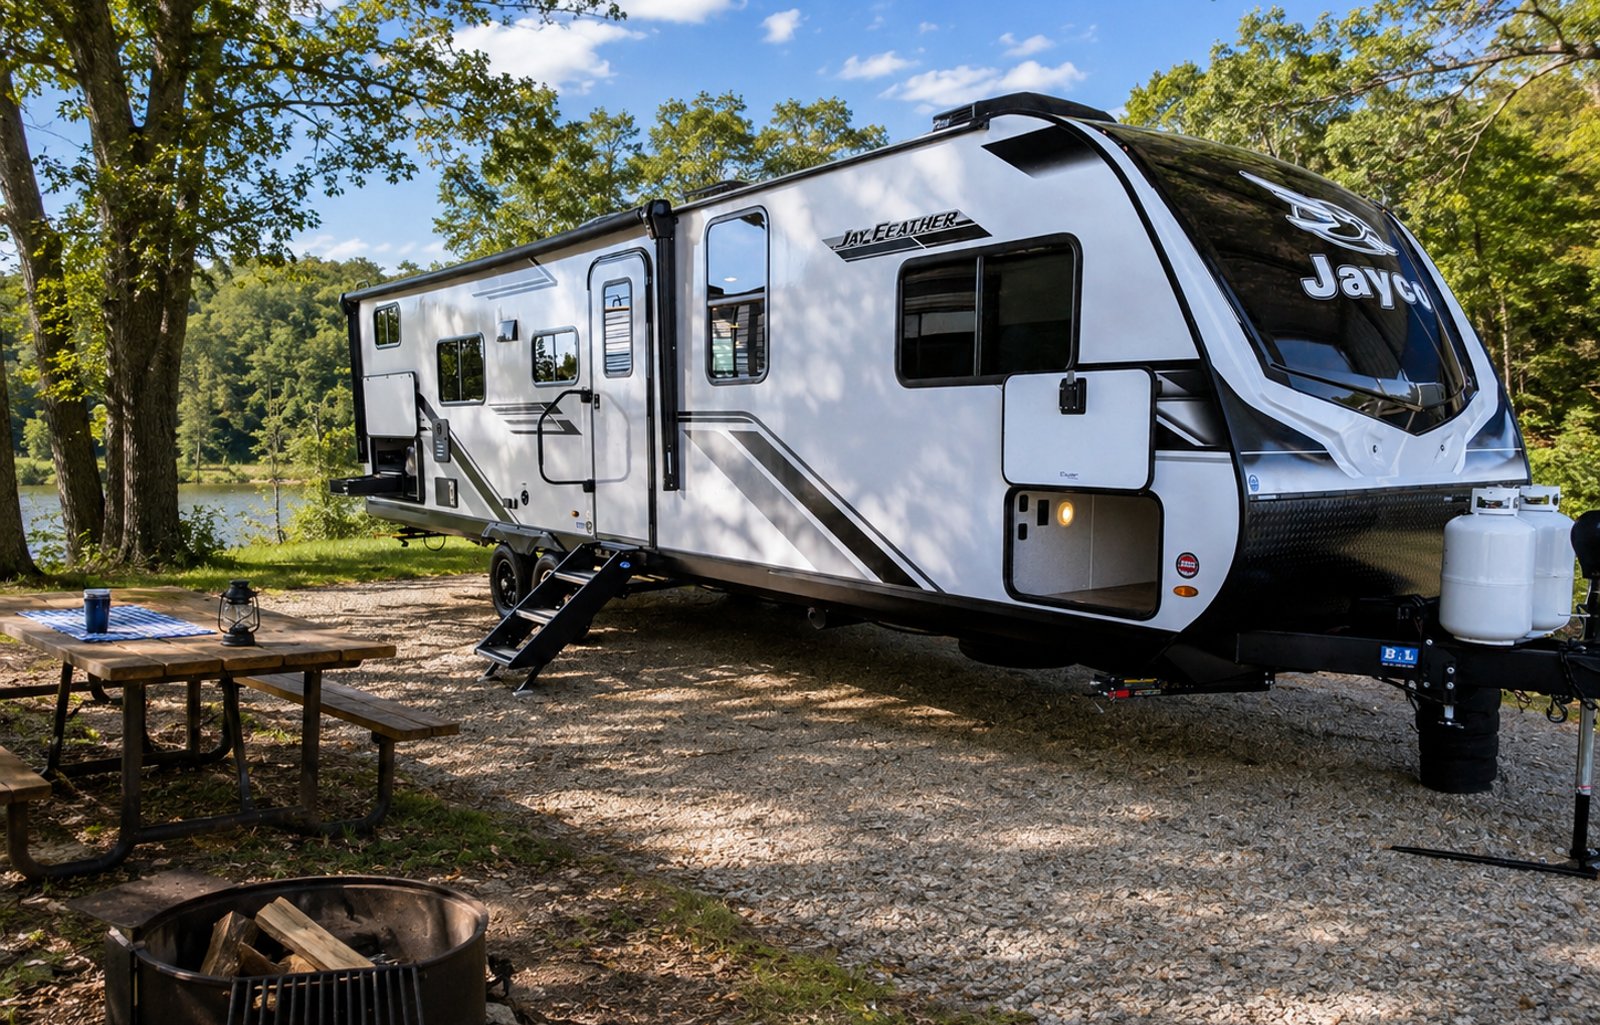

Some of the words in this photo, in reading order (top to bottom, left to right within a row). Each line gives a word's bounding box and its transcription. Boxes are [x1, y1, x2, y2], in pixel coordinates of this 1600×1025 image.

[836, 229, 871, 249] JAY
[872, 210, 960, 242] FEATHER
[1300, 253, 1434, 312] Jayco
